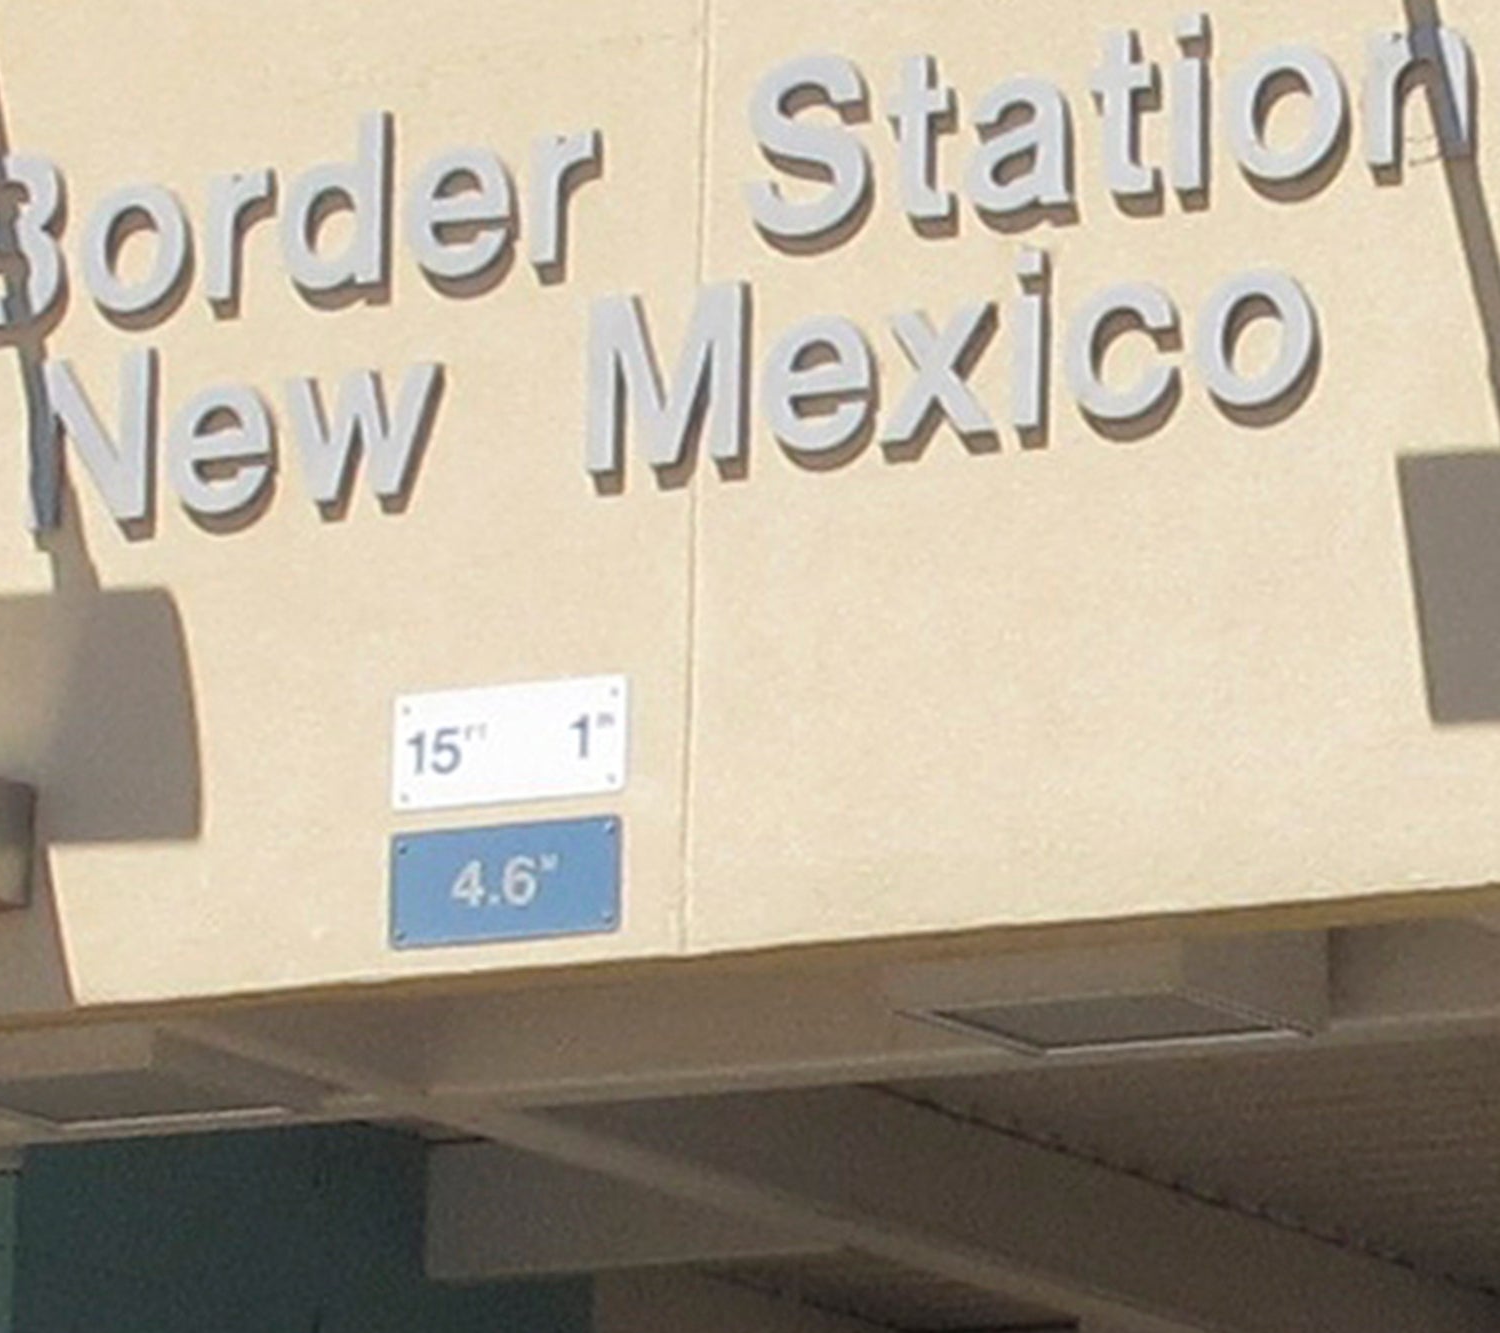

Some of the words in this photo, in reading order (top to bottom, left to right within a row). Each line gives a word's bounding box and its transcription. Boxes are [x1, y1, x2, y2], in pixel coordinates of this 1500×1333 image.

[741, 13, 1477, 242] Station
[28, 347, 443, 536] New
[585, 247, 1319, 480] Mexico
